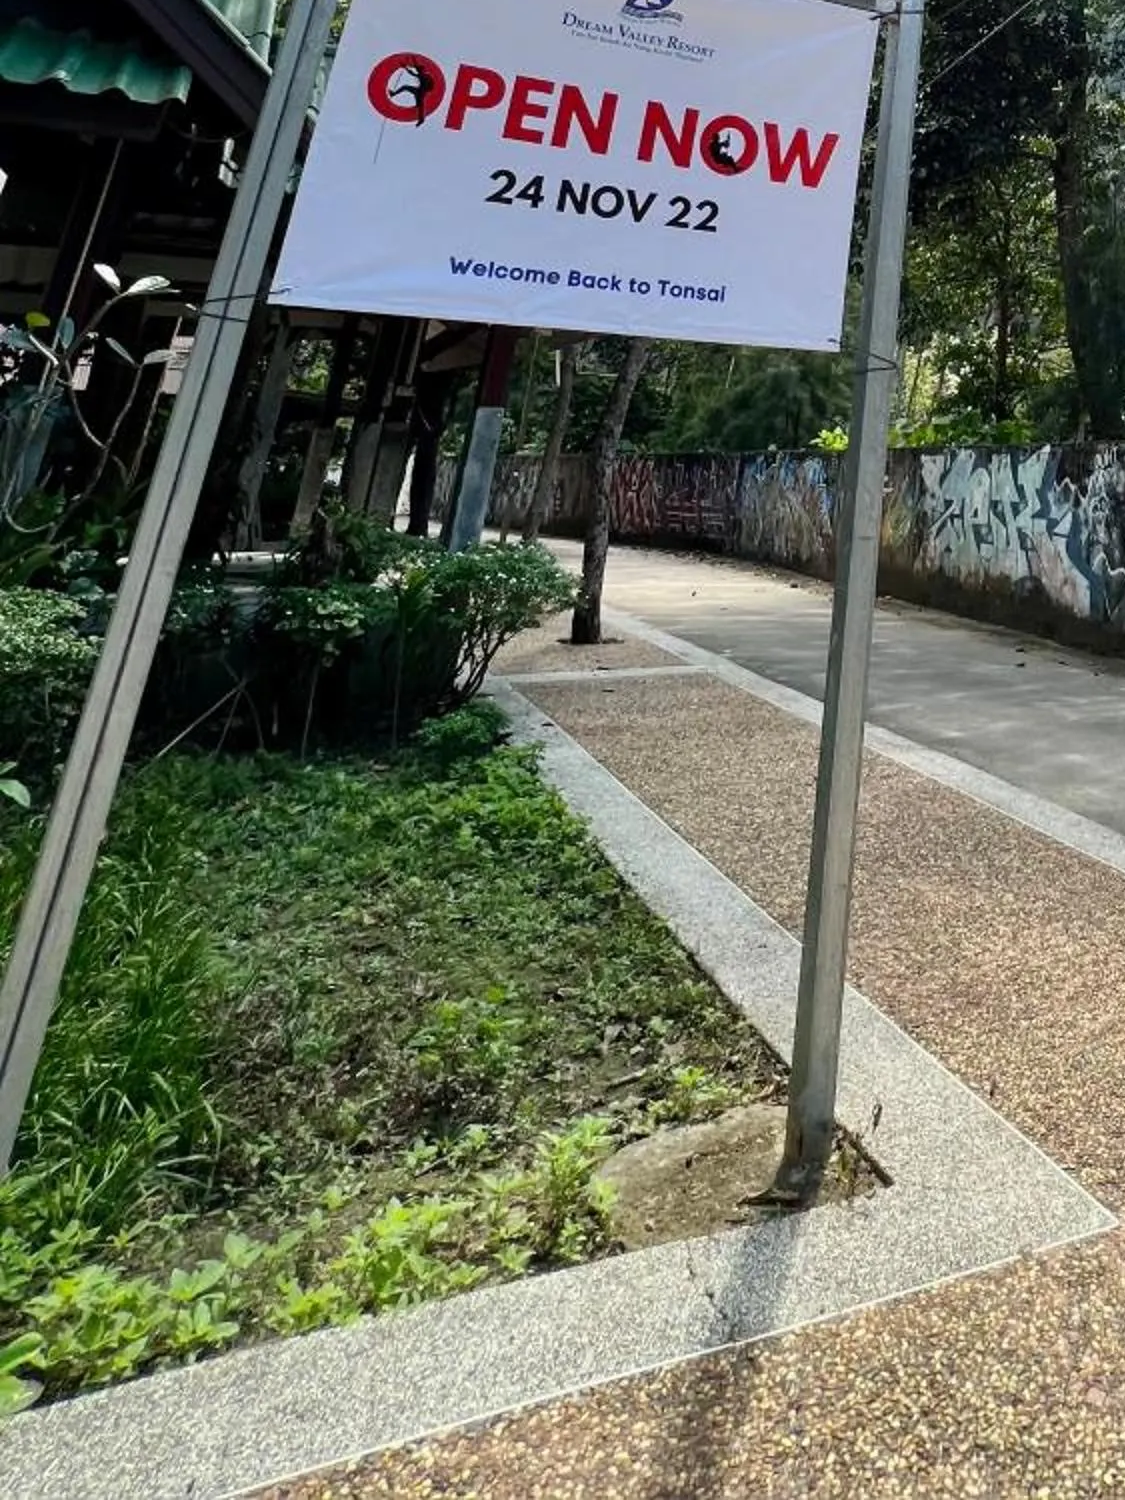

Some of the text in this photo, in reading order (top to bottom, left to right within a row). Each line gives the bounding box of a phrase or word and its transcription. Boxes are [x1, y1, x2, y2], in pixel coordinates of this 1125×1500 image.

[366, 51, 840, 188] OPEN NOW
[484, 168, 720, 233] 24 NOV 22
[449, 256, 727, 303] Welcome Back to Tonsai
